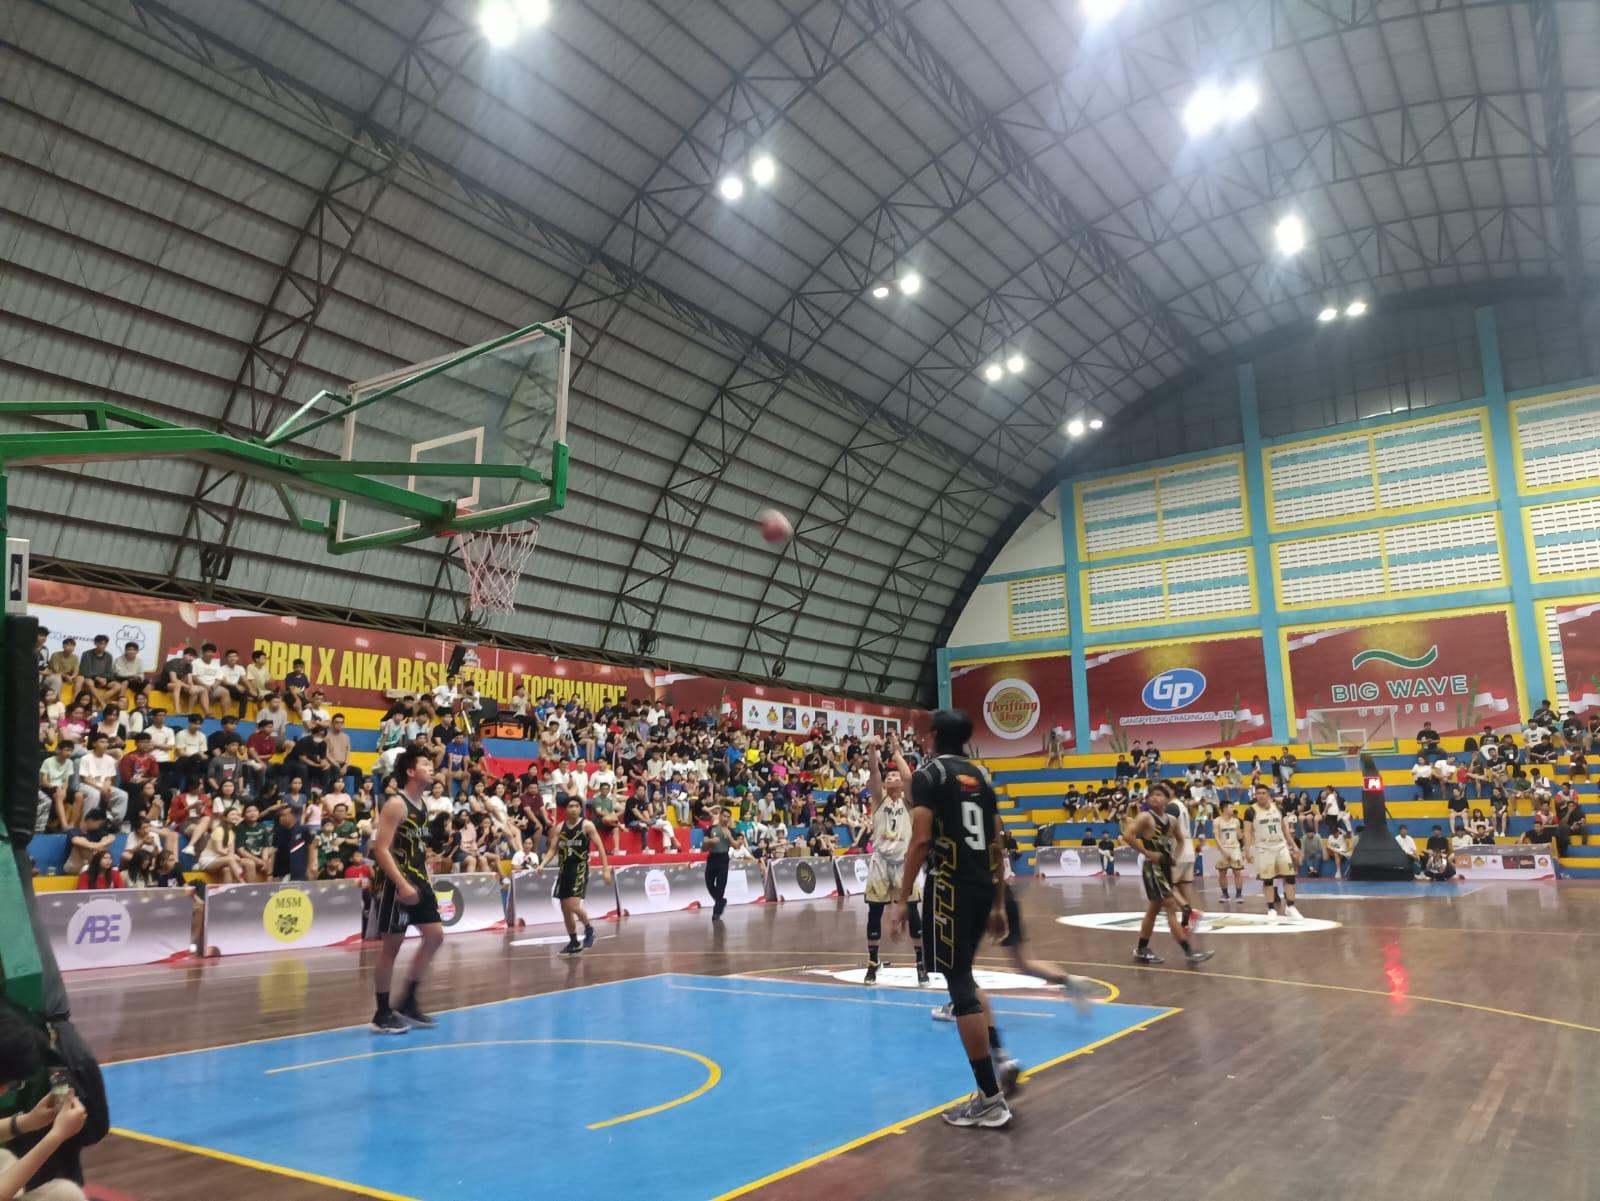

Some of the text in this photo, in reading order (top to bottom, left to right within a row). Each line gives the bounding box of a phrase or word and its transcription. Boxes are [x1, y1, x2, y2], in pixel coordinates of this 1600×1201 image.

[316, 647, 336, 685] X
[339, 650, 392, 691] AIKA
[1331, 674, 1469, 703] BIG WAVE
[961, 801, 987, 850] 9
[275, 895, 302, 909] MSM
[75, 913, 121, 945] ABE
